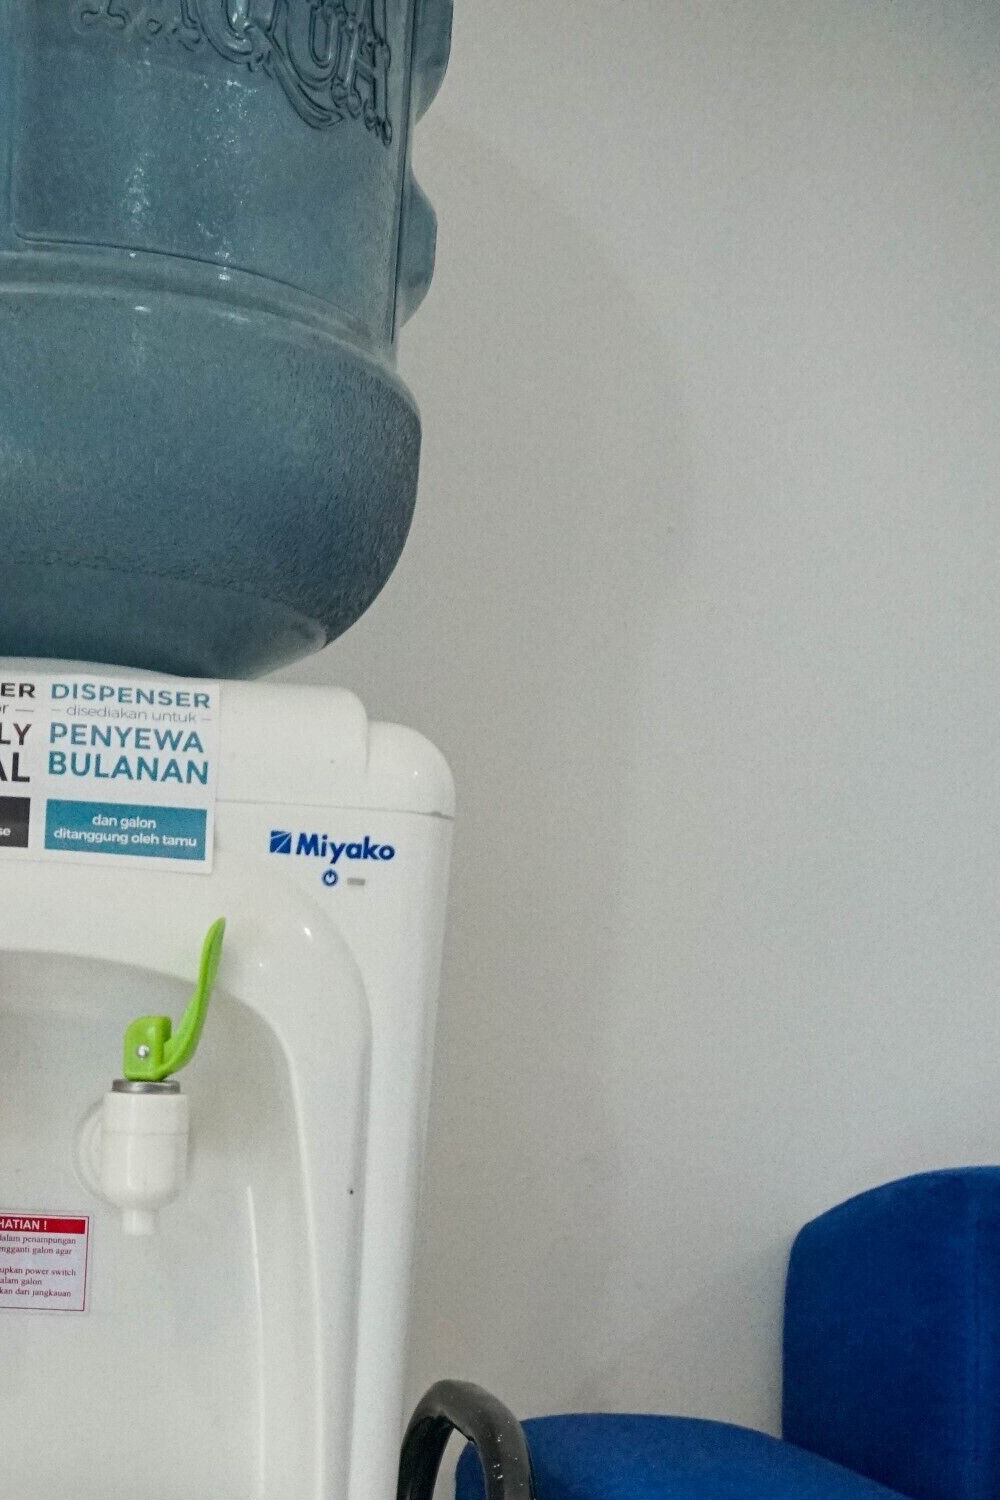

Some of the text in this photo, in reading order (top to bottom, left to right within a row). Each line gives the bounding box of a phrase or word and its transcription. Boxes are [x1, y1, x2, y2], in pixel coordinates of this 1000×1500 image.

[51, 683, 210, 709] DISPENSER
[66, 705, 196, 723] disediakan untuk
[50, 721, 204, 753] PENYEWA
[48, 751, 209, 785] BULANAN
[92, 814, 156, 830] dan galon
[53, 827, 197, 847] ditanggung oleh tamu
[295, 832, 396, 865] Miyako
[43, 1220, 48, 1231] !
[22, 1236, 76, 1246] penampungan
[32, 1246, 54, 1254] galon
[55, 1248, 72, 1256] agar
[25, 1267, 49, 1276] power
[51, 1268, 76, 1277] switch
[20, 1277, 43, 1287] galon
[15, 1288, 30, 1296] dari
[32, 1289, 72, 1299] jangkauan
